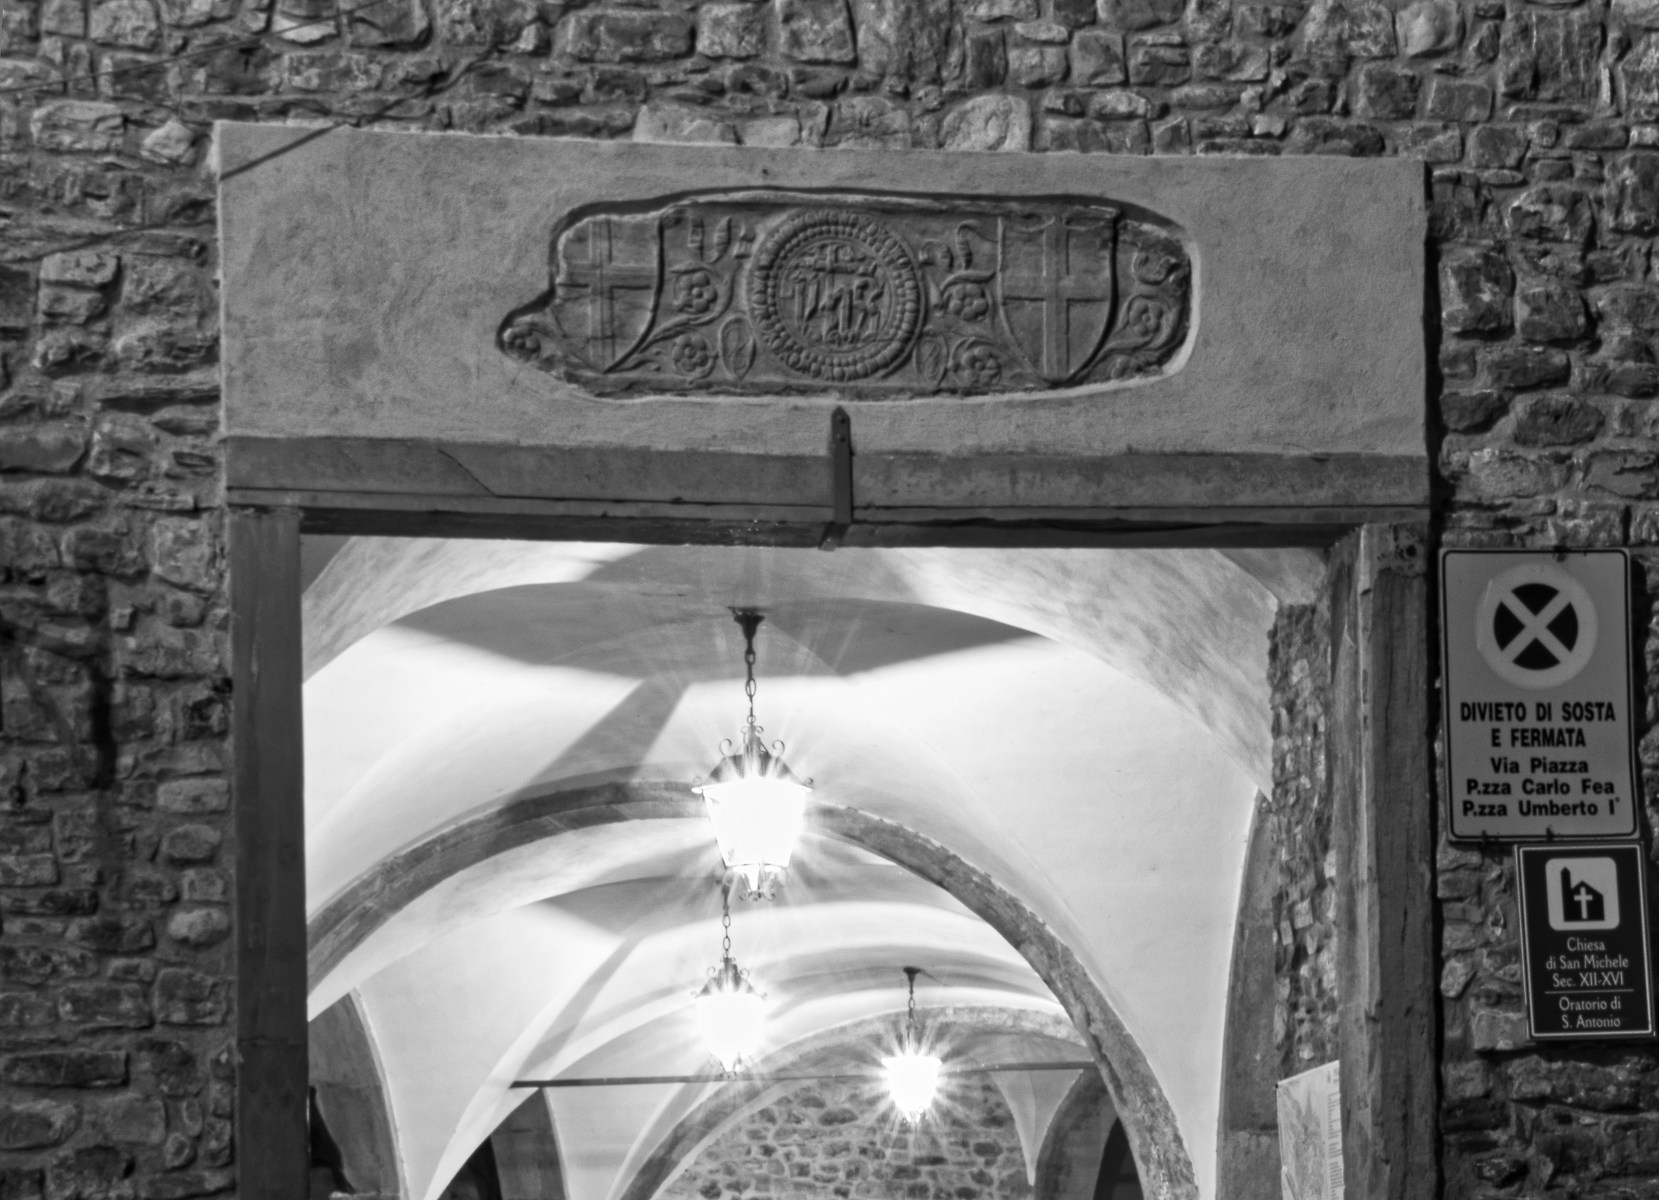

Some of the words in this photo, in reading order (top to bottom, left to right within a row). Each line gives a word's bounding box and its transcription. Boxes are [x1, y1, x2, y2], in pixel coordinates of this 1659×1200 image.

[1460, 702, 1527, 722] DIVIETO
[1536, 702, 1552, 722] DI
[1561, 702, 1616, 722] SOSTA
[1491, 728, 1501, 747] E
[1511, 728, 1586, 747] FERMATA
[1490, 757, 1520, 774] Via
[1530, 757, 1589, 774] Piazza
[1466, 778, 1512, 795] P.zza
[1521, 778, 1571, 795] Carlo
[1581, 778, 1615, 795] Fea
[1462, 800, 1508, 817] P.zza
[1518, 800, 1598, 817] Umberto
[1567, 937, 1605, 951] Chiesa
[1546, 956, 1557, 970] di
[1559, 955, 1580, 970] San
[1584, 954, 1629, 969] Michele
[1552, 973, 1576, 987] Sec.
[1579, 972, 1623, 986] XII-XVI
[1559, 996, 1607, 1011] Oratorio
[1610, 995, 1621, 1010] di
[1561, 1015, 1573, 1029] S.
[1576, 1013, 1621, 1028] Antonio
